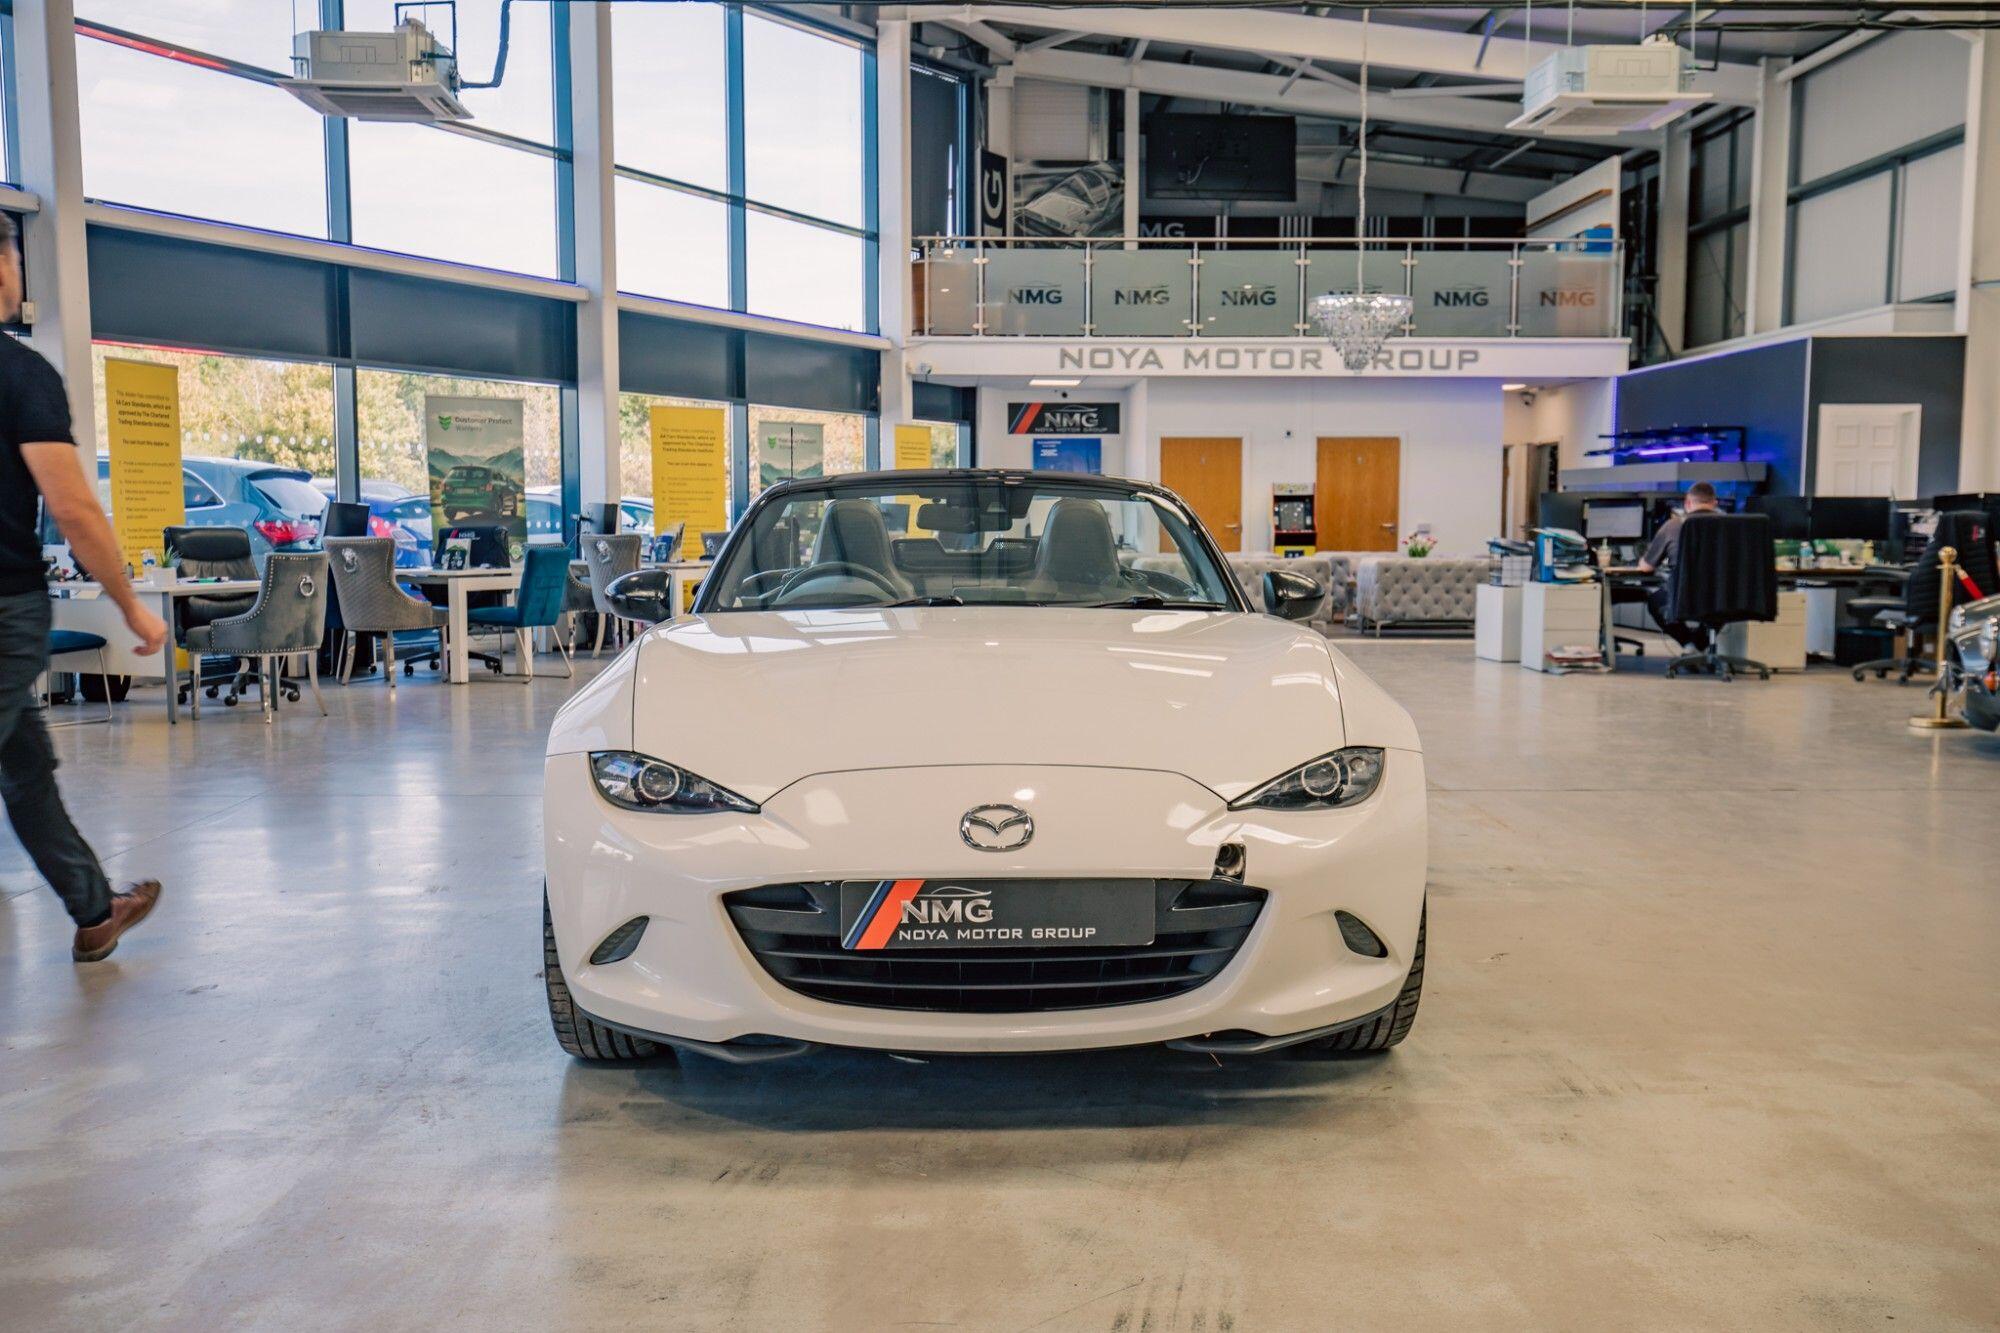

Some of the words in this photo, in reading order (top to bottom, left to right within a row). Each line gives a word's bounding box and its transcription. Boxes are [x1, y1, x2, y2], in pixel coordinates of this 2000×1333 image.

[1138, 222, 1186, 238] MG
[1008, 290, 1063, 305] NMG
[1114, 290, 1170, 305] NMG
[1221, 290, 1277, 306] NMG
[1433, 291, 1489, 307] NMG
[1540, 291, 1596, 307] NMG
[1059, 347, 1164, 370] NOYA
[1183, 347, 1322, 370] MOTOR
[1364, 348, 1481, 371] ROUP
[1044, 412, 1099, 427] NMG
[900, 899, 993, 924] NMG
[899, 929, 949, 941] NOYA
[957, 928, 1023, 940] MOTOR
[1031, 927, 1096, 939] GROUP
